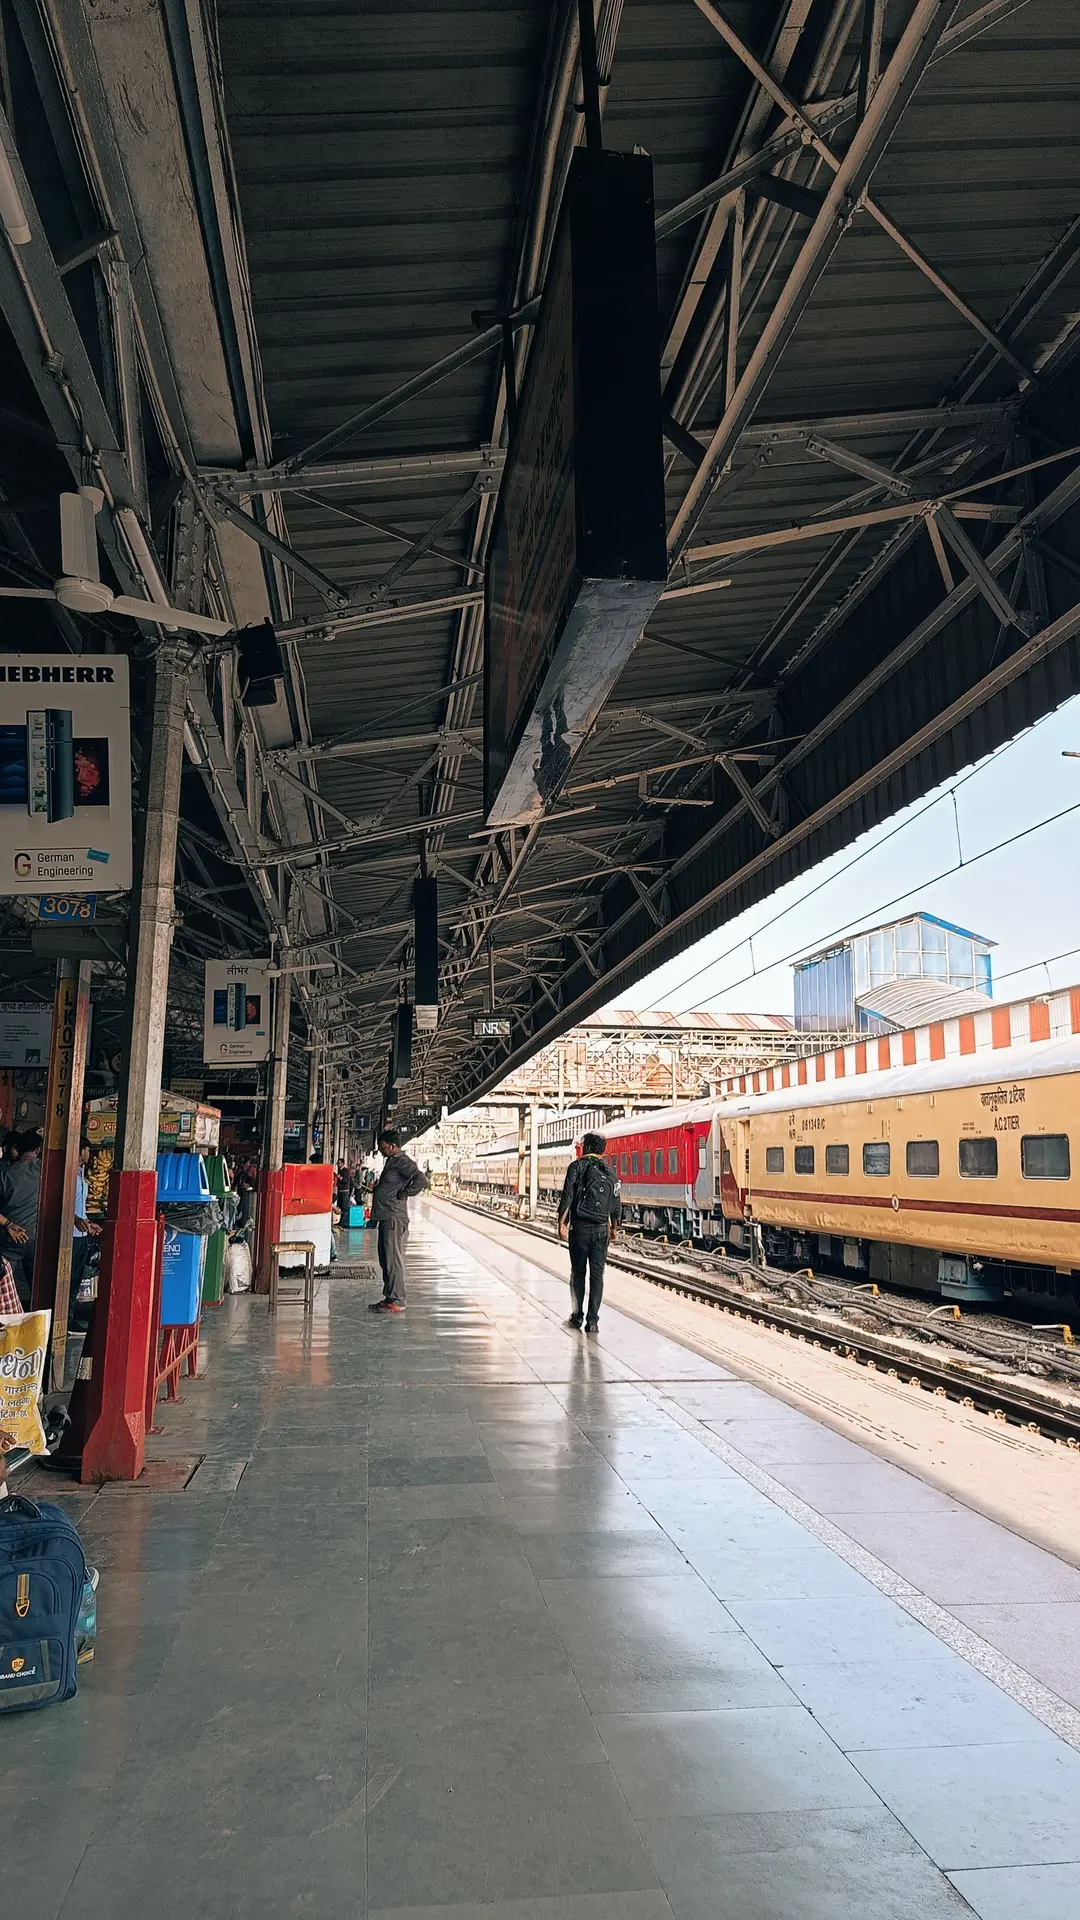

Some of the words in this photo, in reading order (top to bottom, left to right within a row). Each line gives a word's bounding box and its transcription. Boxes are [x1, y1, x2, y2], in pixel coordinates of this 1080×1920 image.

[37, 853, 75, 863] German
[37, 866, 94, 877] Engineering
[43, 897, 91, 918] 3078
[226, 965, 249, 975] लीभेर
[359, 1118, 365, 1127] 1
[16, 1668, 36, 1677] CHOICE
